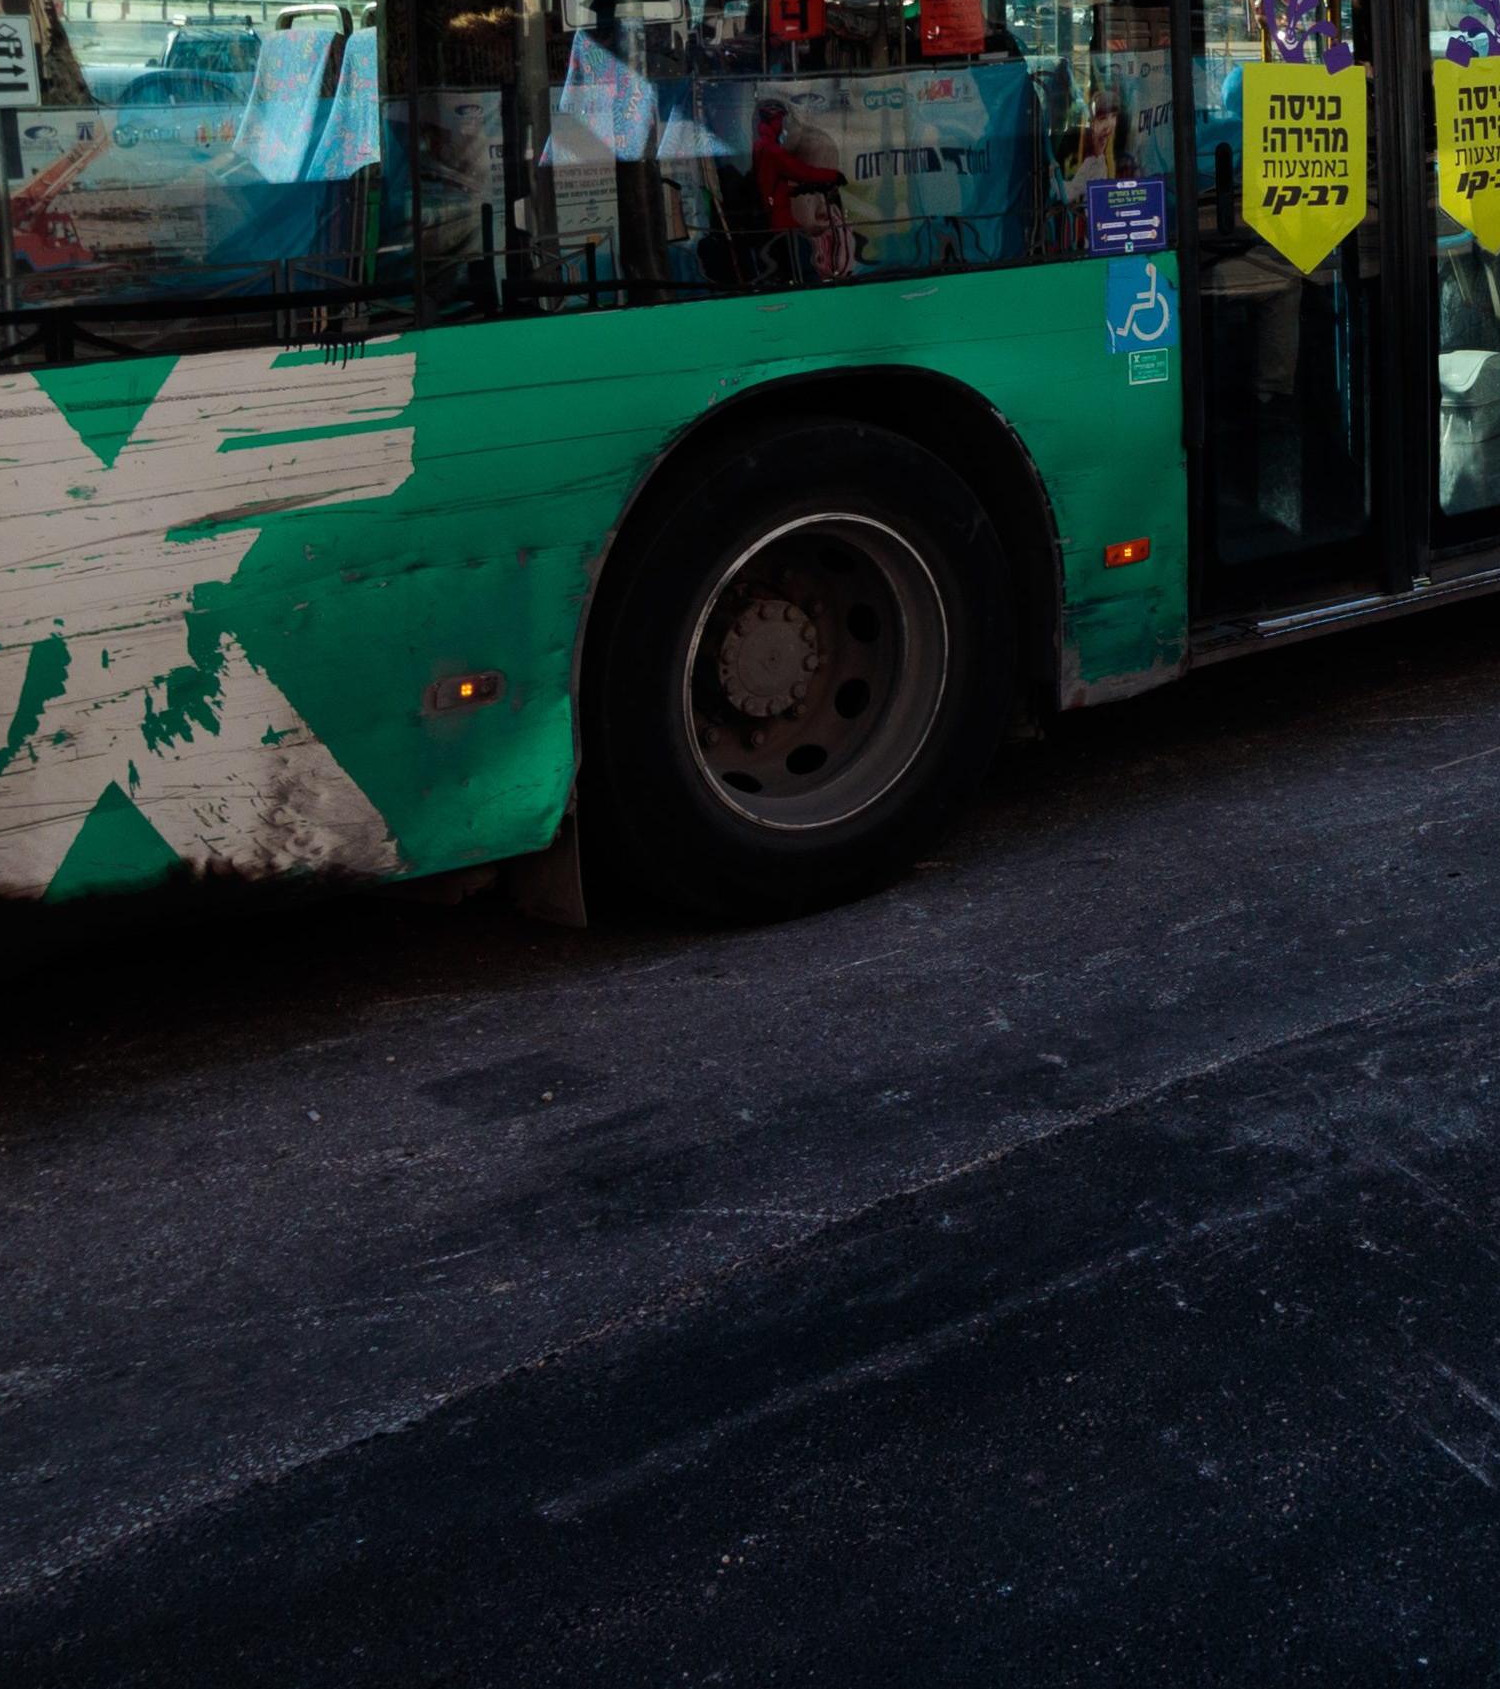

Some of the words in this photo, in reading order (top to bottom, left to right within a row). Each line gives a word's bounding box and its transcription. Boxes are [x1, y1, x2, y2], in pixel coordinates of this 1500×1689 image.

[1270, 94, 1341, 121] כניסה
[1262, 127, 1349, 152] מהירה!
[1262, 158, 1349, 180] באמצעות
